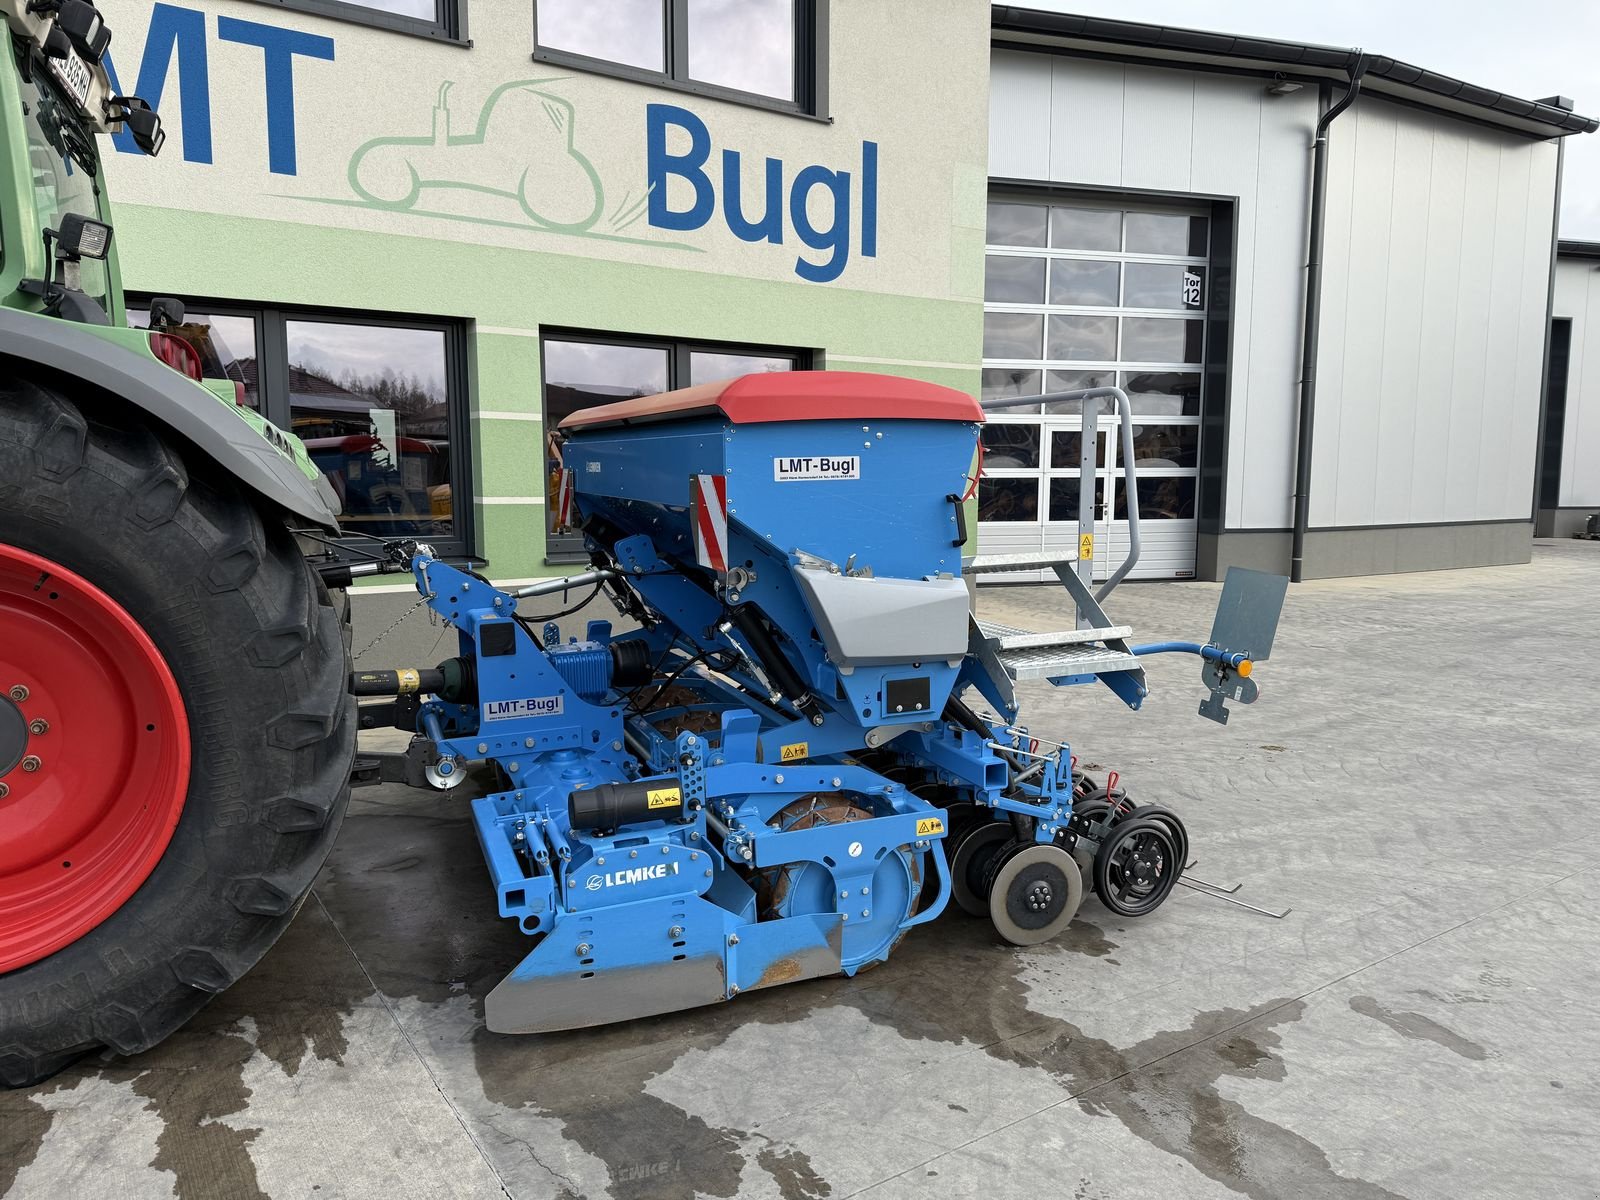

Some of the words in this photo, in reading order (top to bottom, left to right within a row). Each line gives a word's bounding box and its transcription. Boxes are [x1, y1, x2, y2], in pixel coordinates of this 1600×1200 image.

[646, 103, 878, 283] Bugl
[1184, 277, 1200, 287] Tor
[1183, 288, 1200, 303] 12
[779, 457, 855, 475] LMT-Bugl
[488, 696, 559, 715] LMT-Bugl
